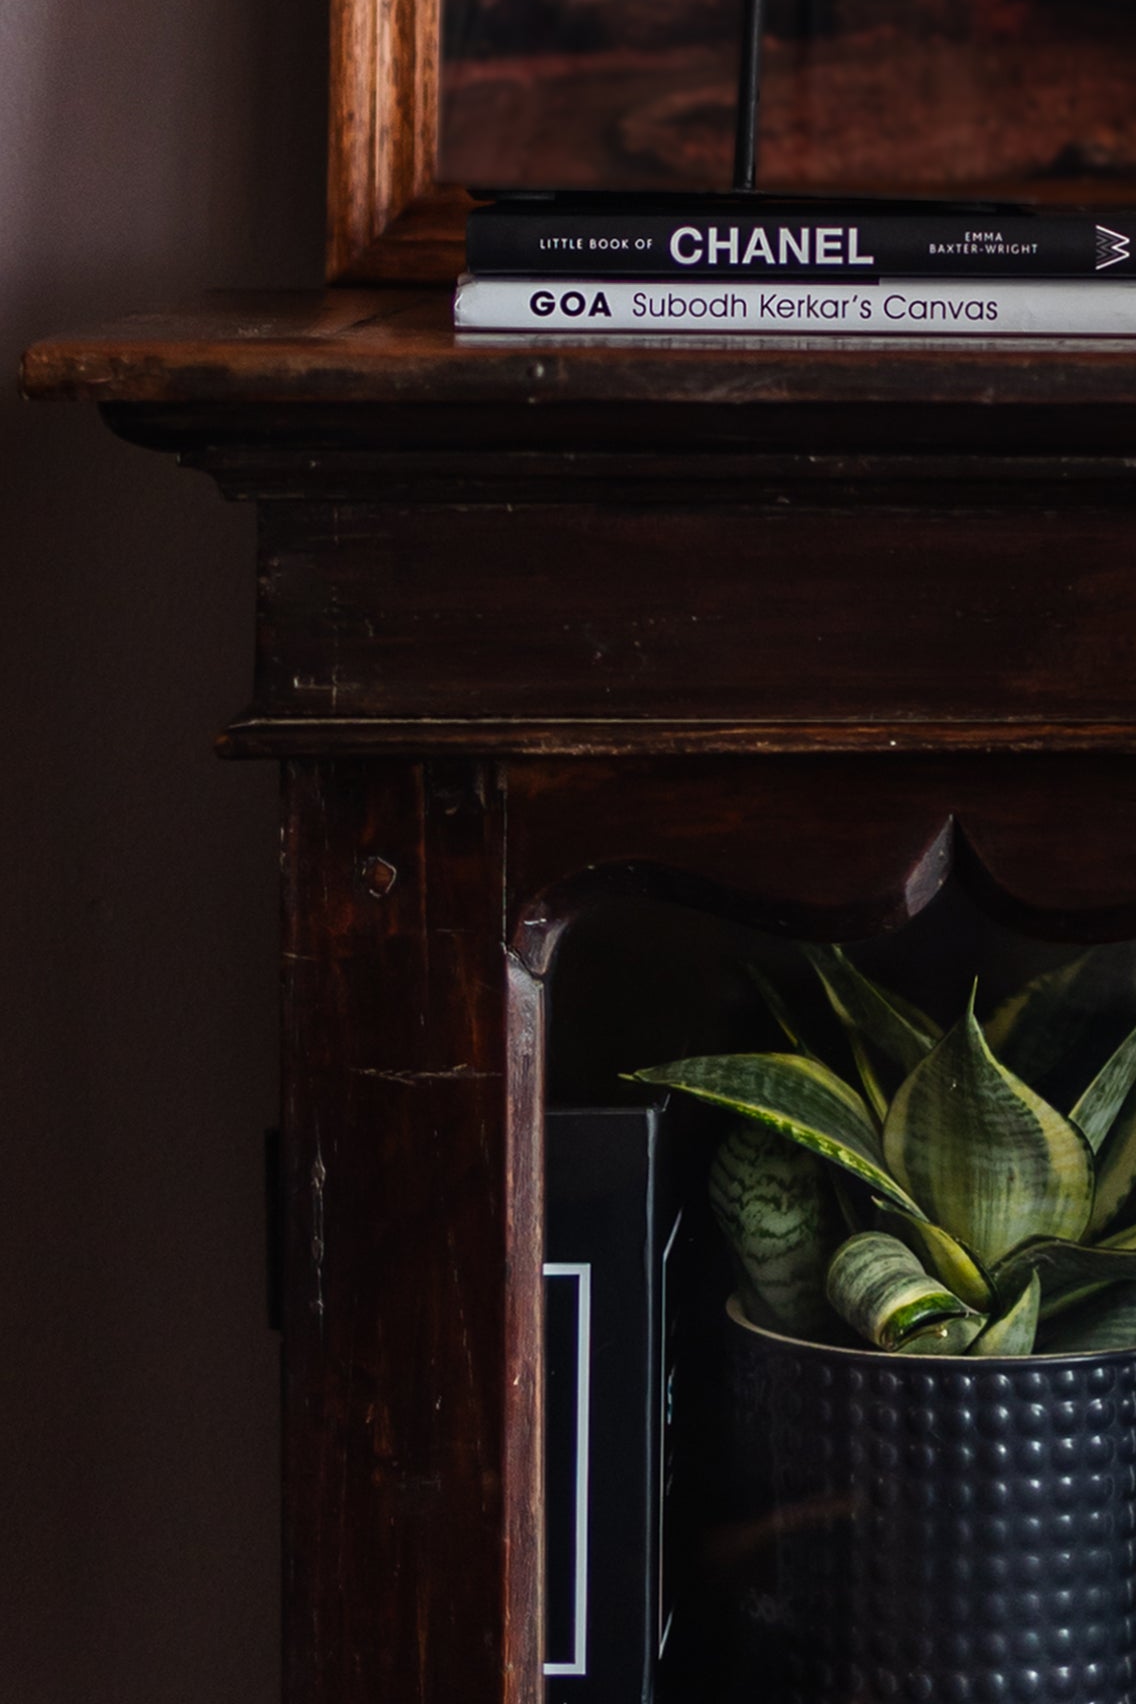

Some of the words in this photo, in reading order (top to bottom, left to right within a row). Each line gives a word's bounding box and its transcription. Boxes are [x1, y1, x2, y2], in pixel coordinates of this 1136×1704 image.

[539, 237, 583, 250] LITTLE
[589, 238, 629, 250] BOOK
[634, 238, 653, 250] OF
[669, 225, 875, 265] CHANEL
[964, 231, 1003, 242] EMMA
[929, 243, 1038, 255] BAXTER-WRIGHT
[529, 291, 612, 317] GOA
[632, 292, 747, 318] Subodh
[760, 293, 872, 320] Kerkar's
[883, 294, 998, 321] Canvas
